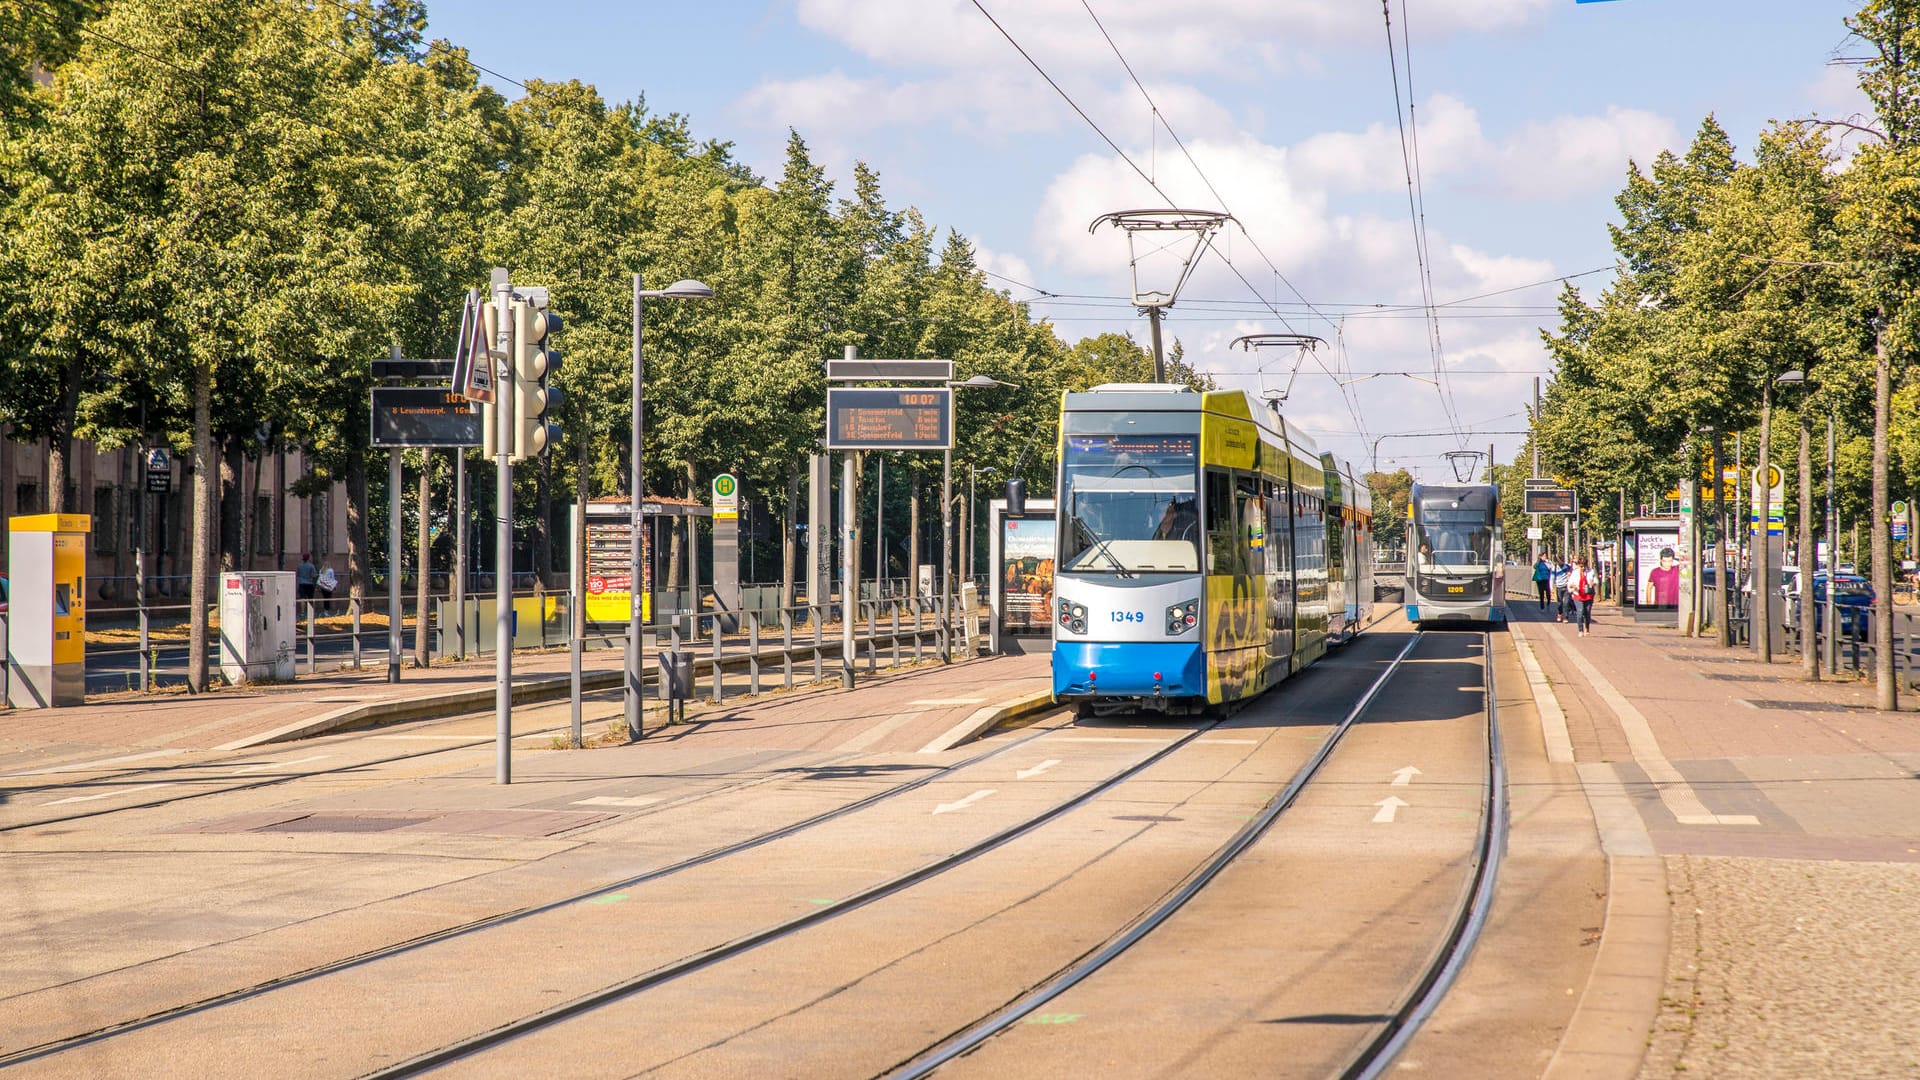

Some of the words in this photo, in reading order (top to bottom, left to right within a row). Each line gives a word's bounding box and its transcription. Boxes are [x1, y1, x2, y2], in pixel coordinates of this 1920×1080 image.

[920, 394, 935, 405] 07
[1640, 535, 1663, 543] Juckt's
[1111, 611, 1144, 622] 1349
